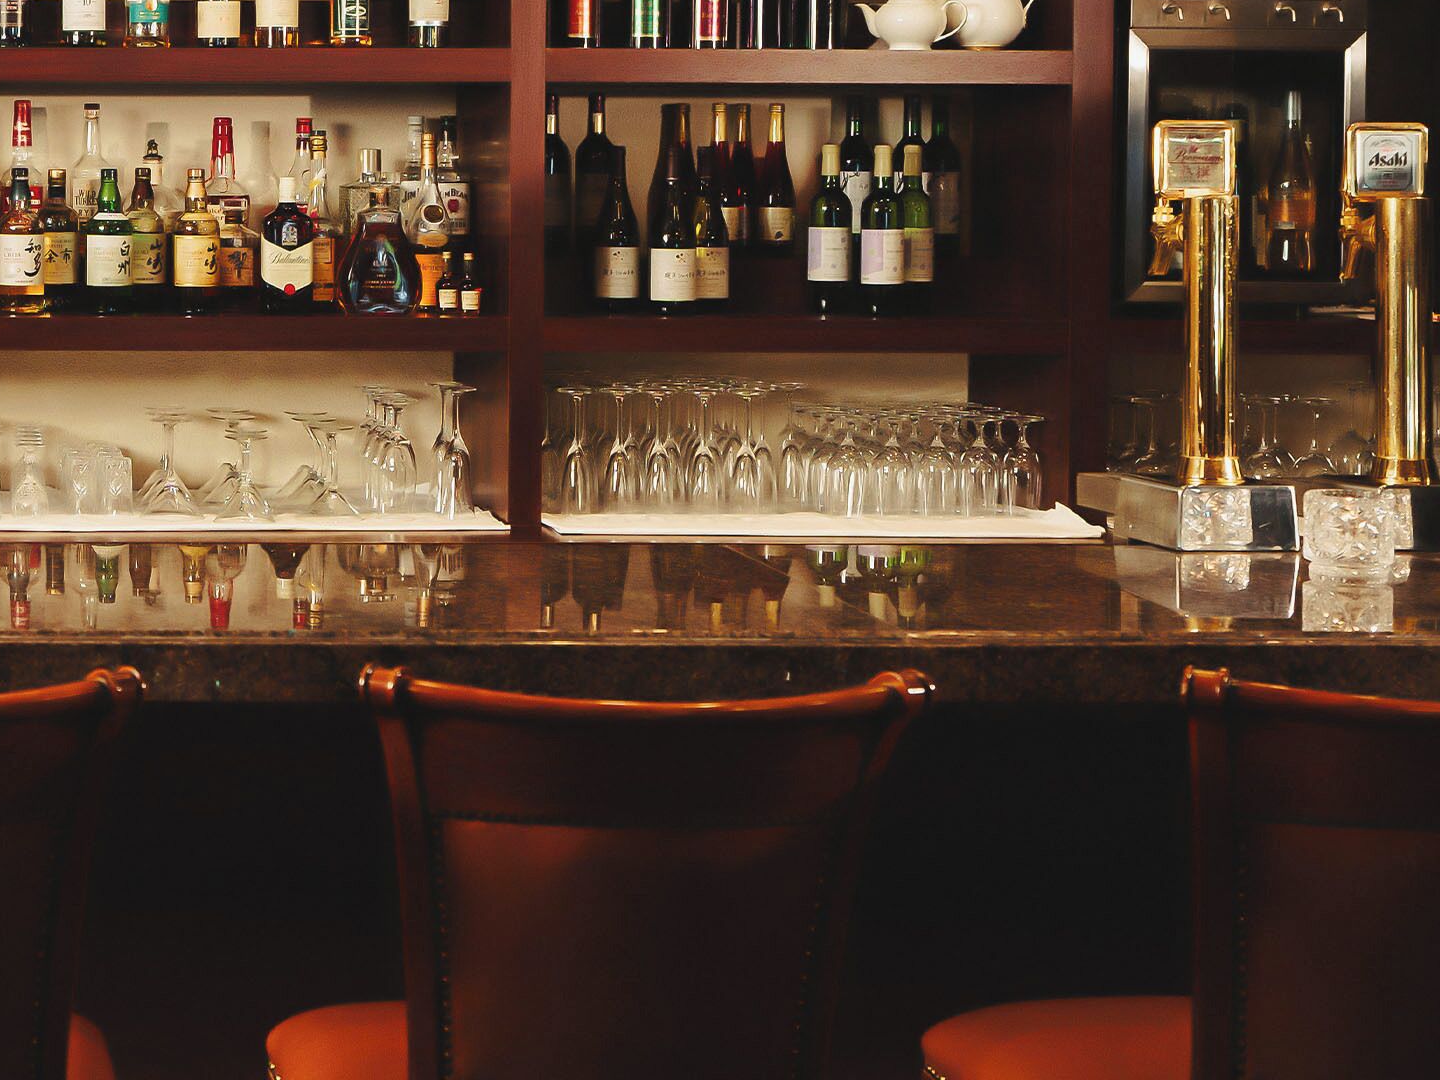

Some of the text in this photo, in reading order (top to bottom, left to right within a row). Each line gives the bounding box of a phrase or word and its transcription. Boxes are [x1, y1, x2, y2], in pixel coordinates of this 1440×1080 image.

[1368, 151, 1408, 167] Asahi
[24, 237, 42, 278] 知多
[44, 247, 73, 264] 余市
[118, 240, 131, 277] 白州
